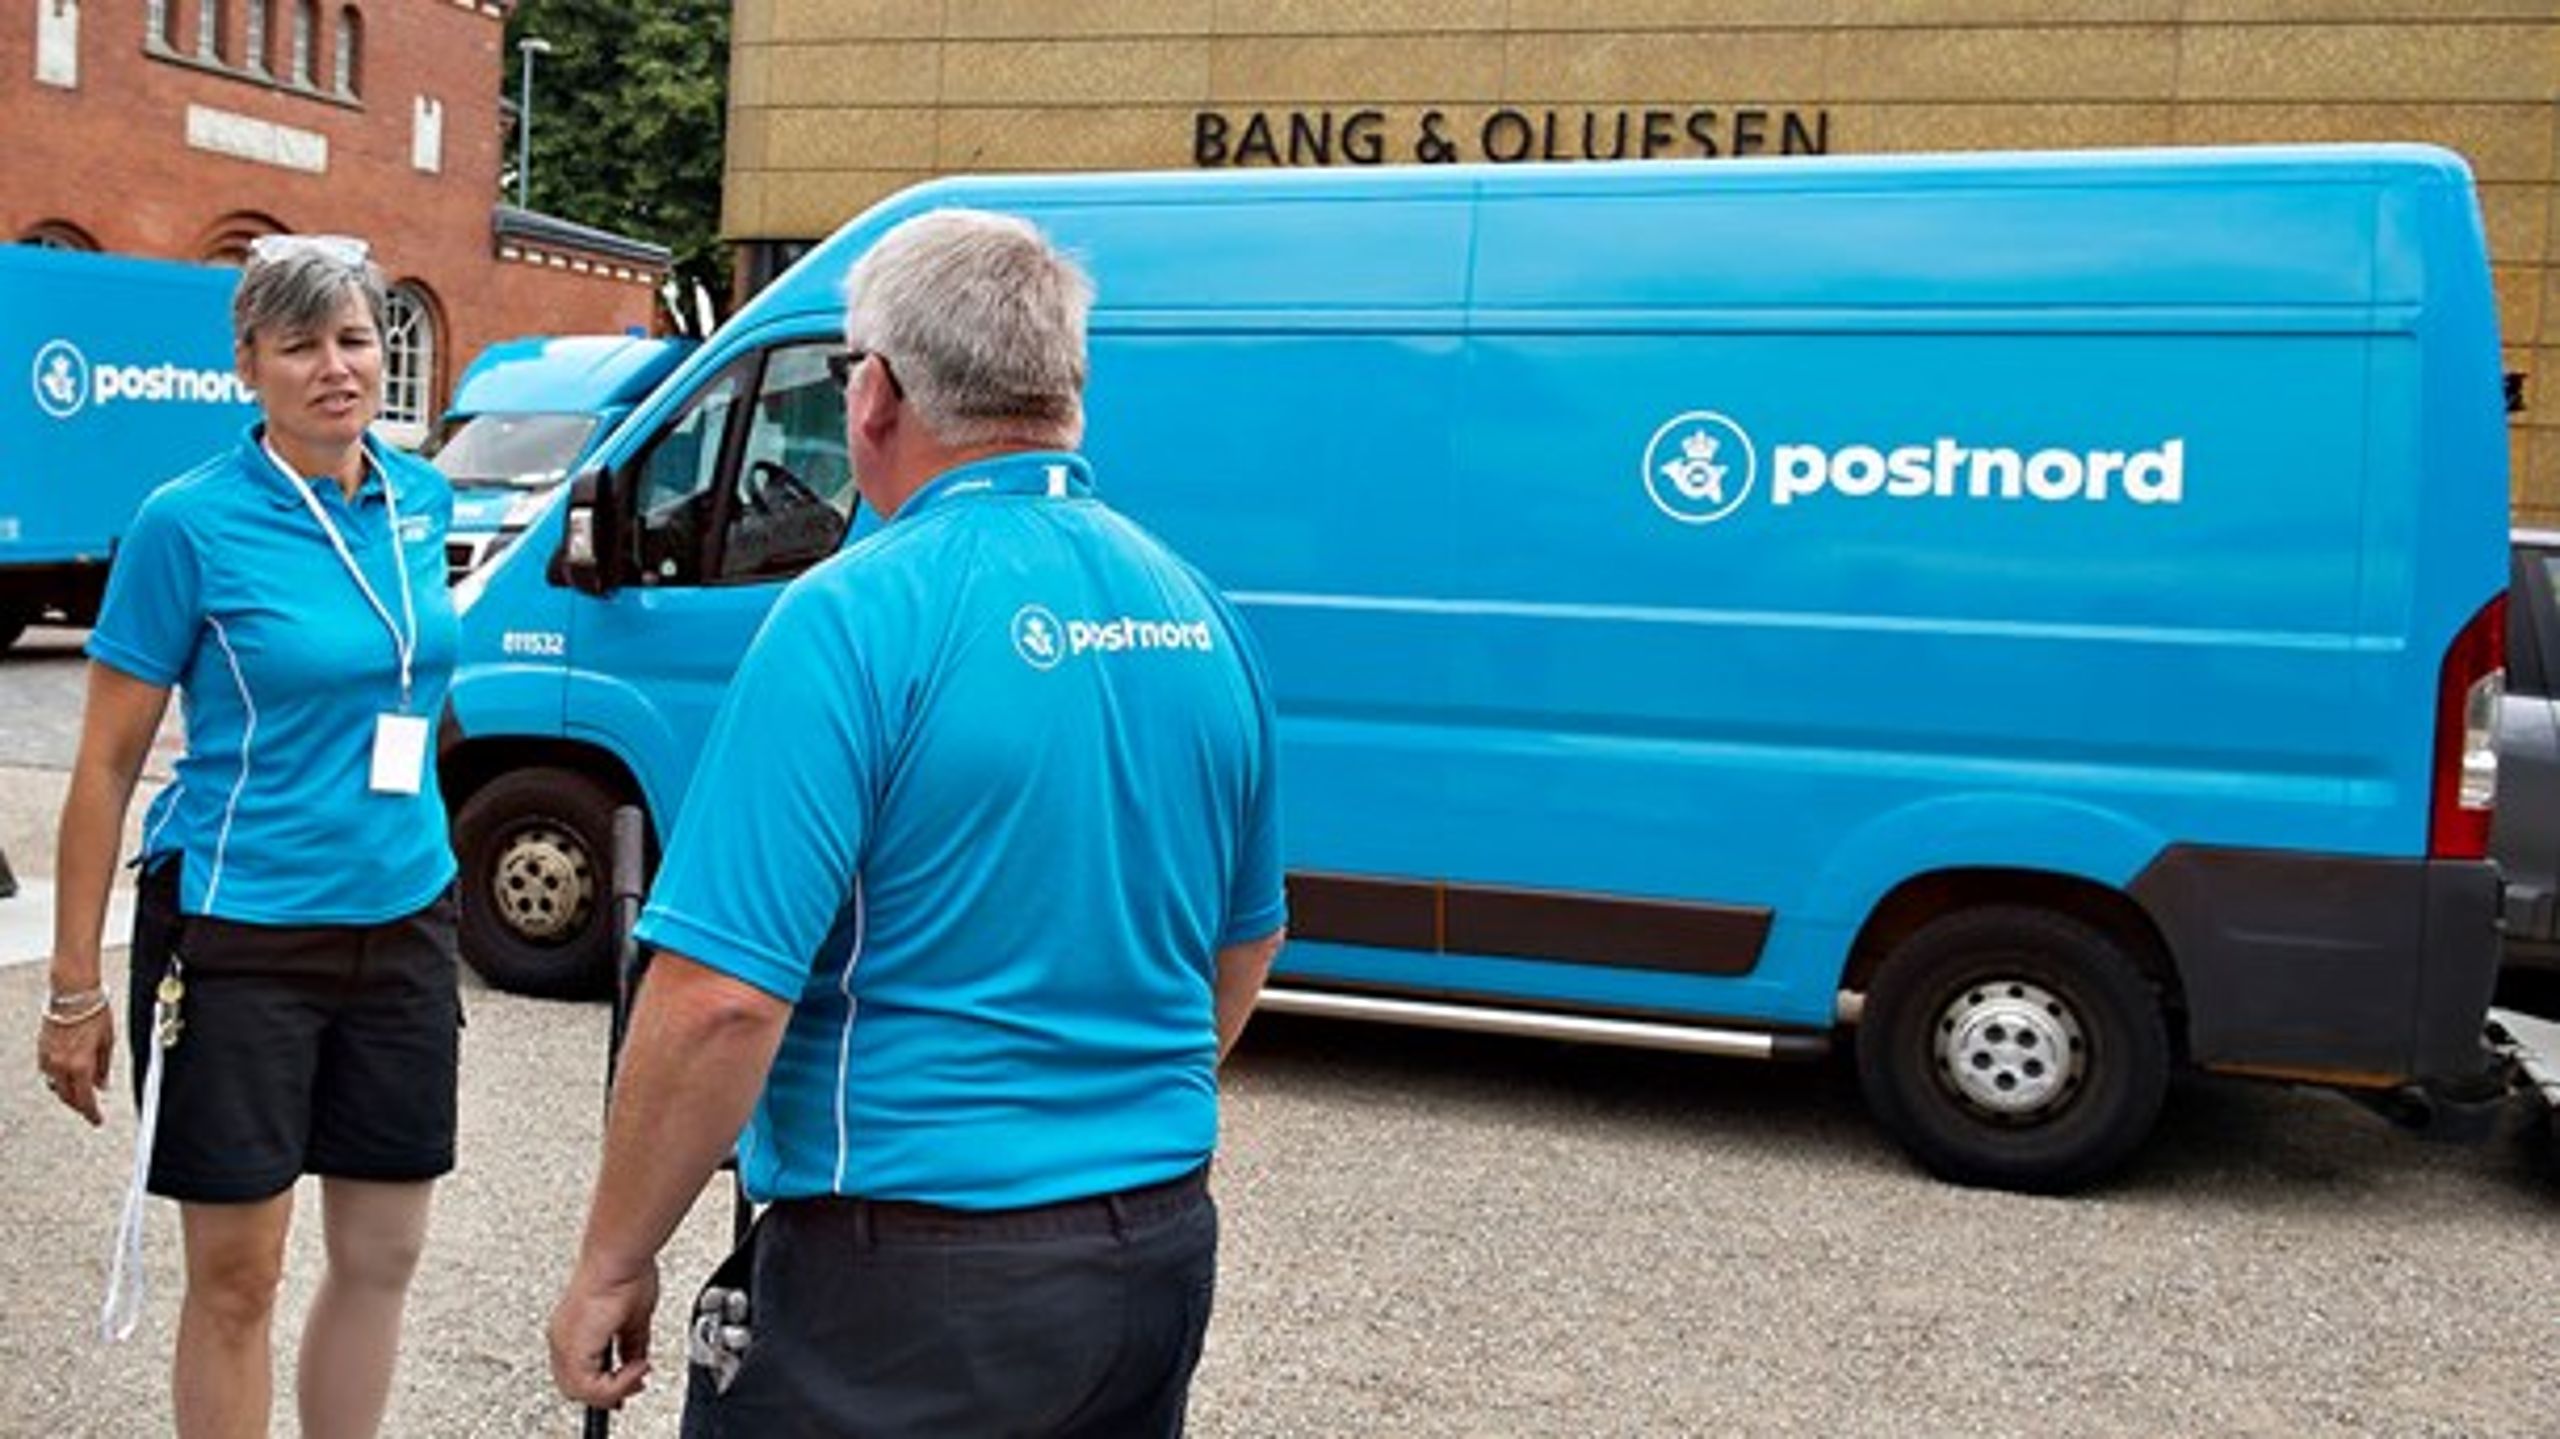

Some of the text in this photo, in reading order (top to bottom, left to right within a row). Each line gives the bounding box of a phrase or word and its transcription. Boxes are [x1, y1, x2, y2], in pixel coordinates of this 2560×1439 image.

[1194, 109, 1827, 167] BANG & OLUFSEN
[1771, 438, 2184, 505] postnord
[1068, 615, 1212, 655] postnord
